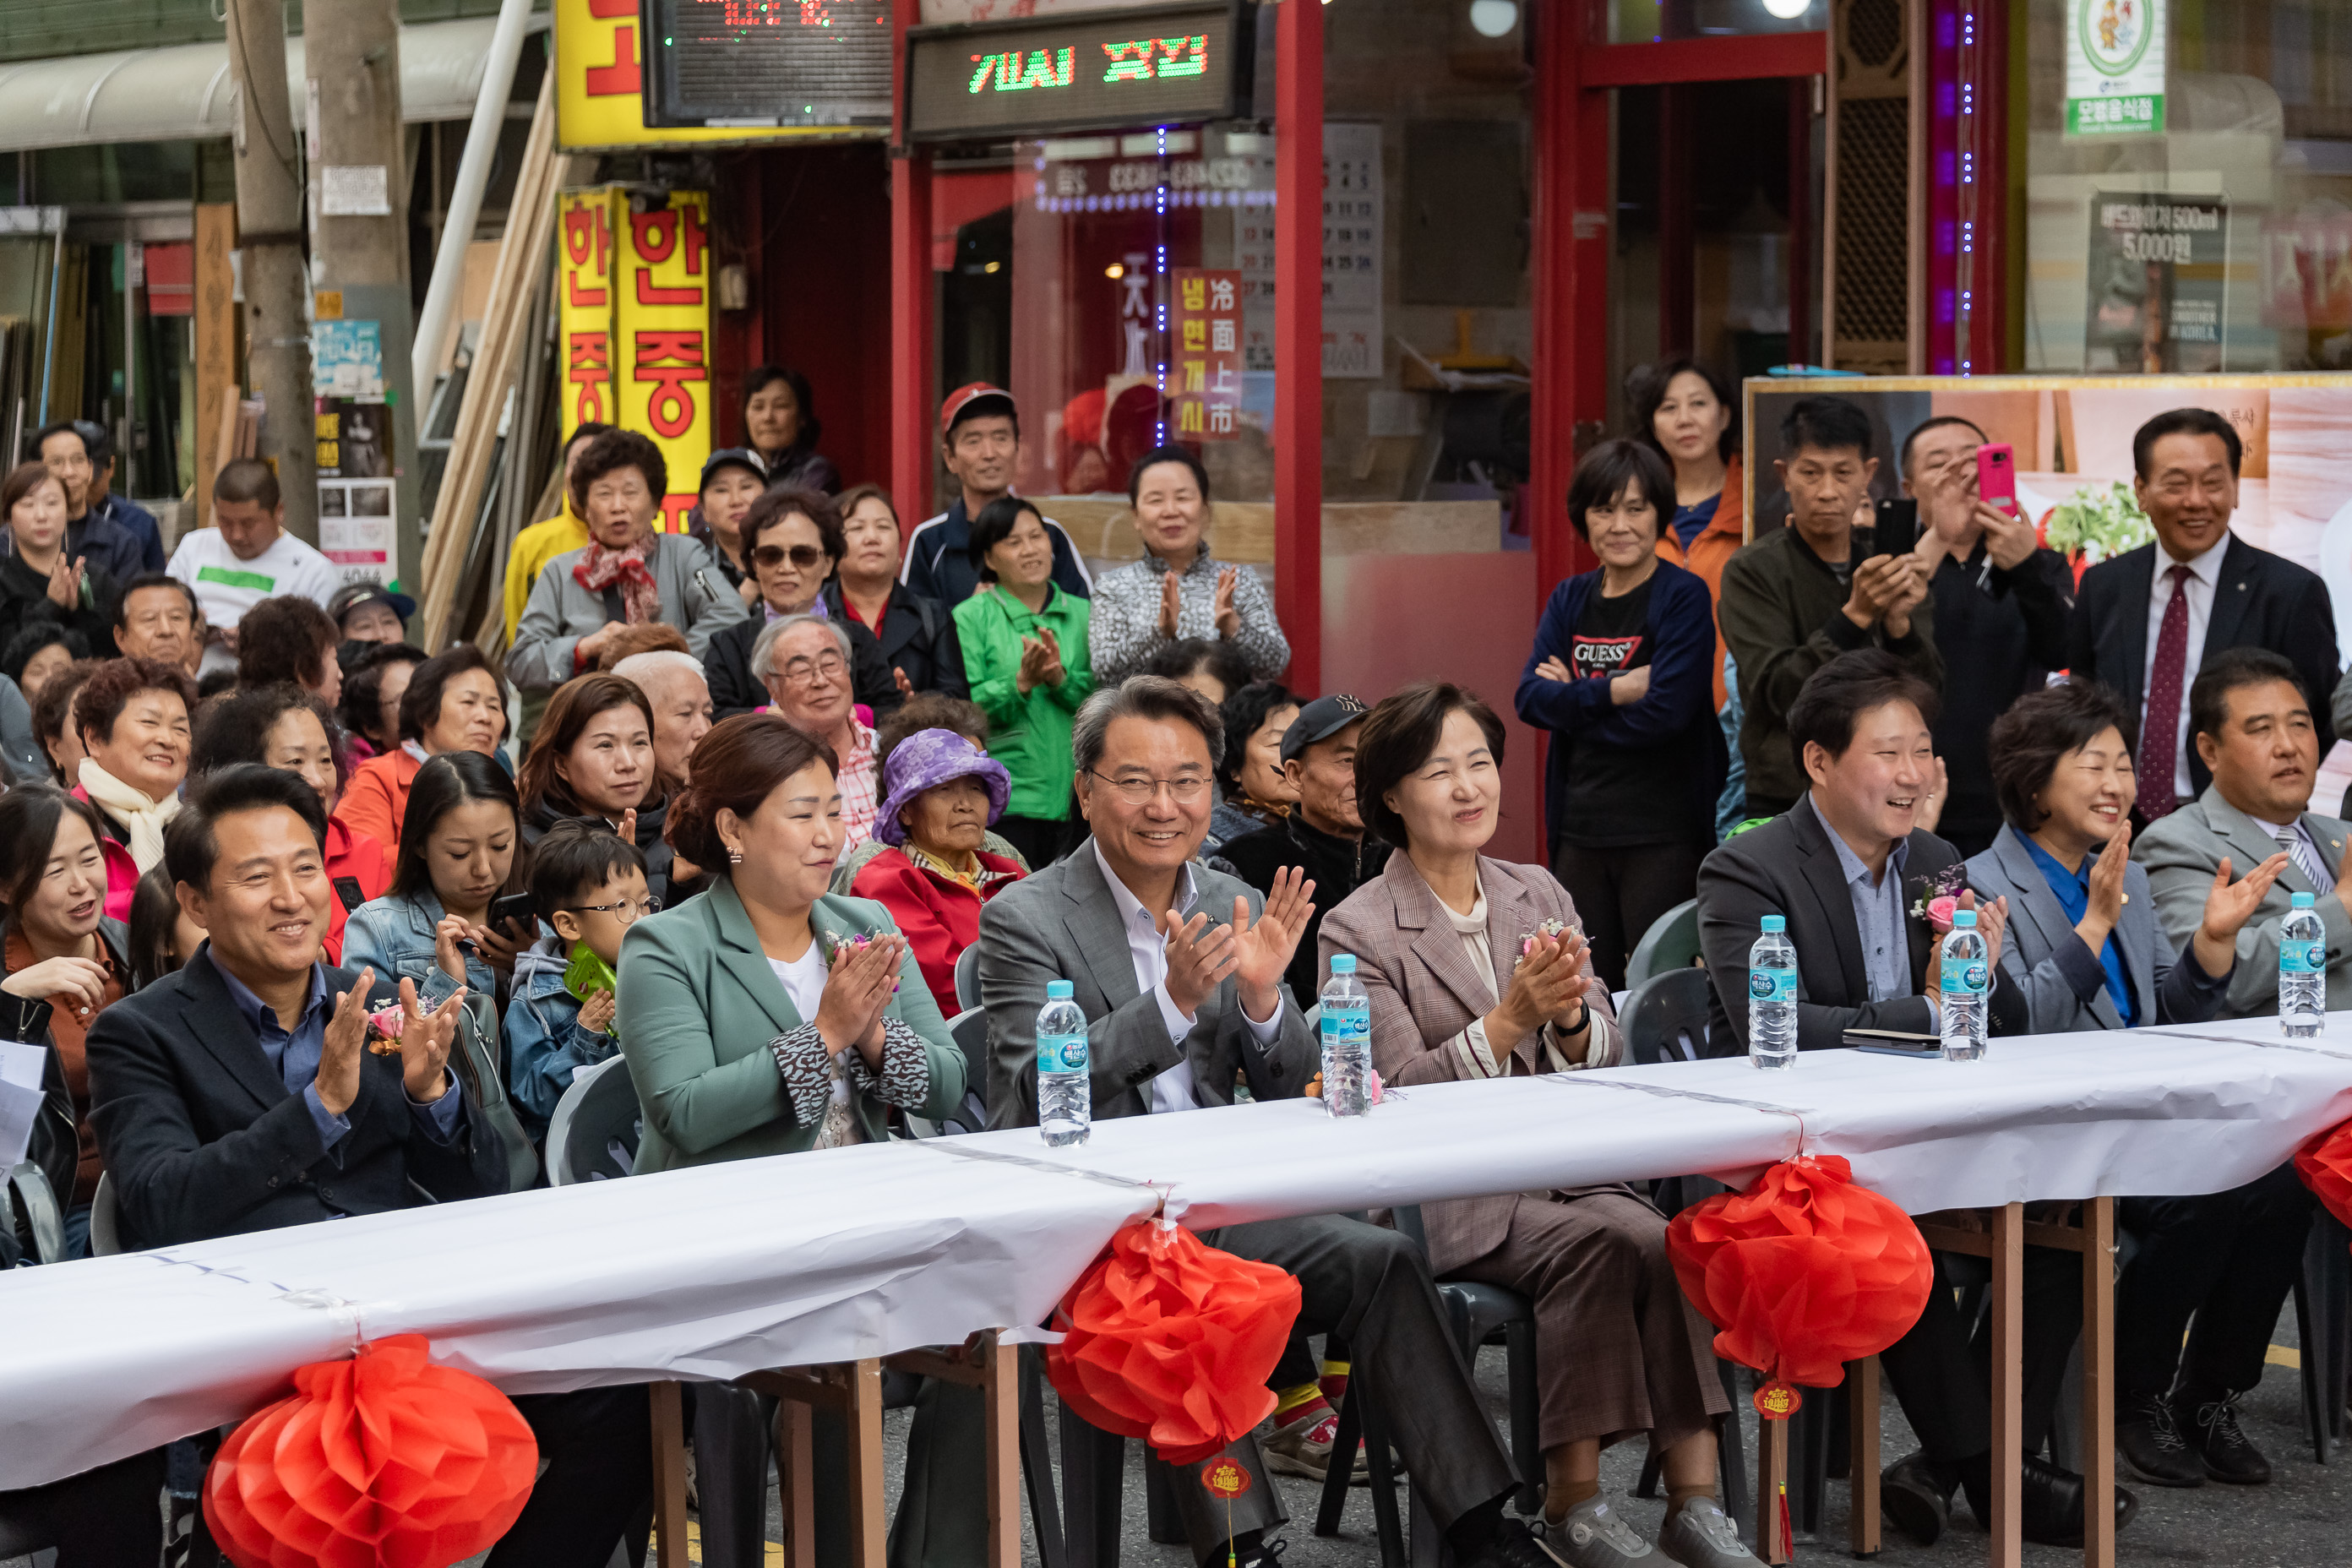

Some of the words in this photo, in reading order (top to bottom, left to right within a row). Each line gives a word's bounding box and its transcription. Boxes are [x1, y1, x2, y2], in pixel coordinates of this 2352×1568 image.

[1210, 277, 1235, 434] 冷面上市
[1574, 643, 1625, 662] GUESS
[1064, 1048, 1086, 1060] 백산수
